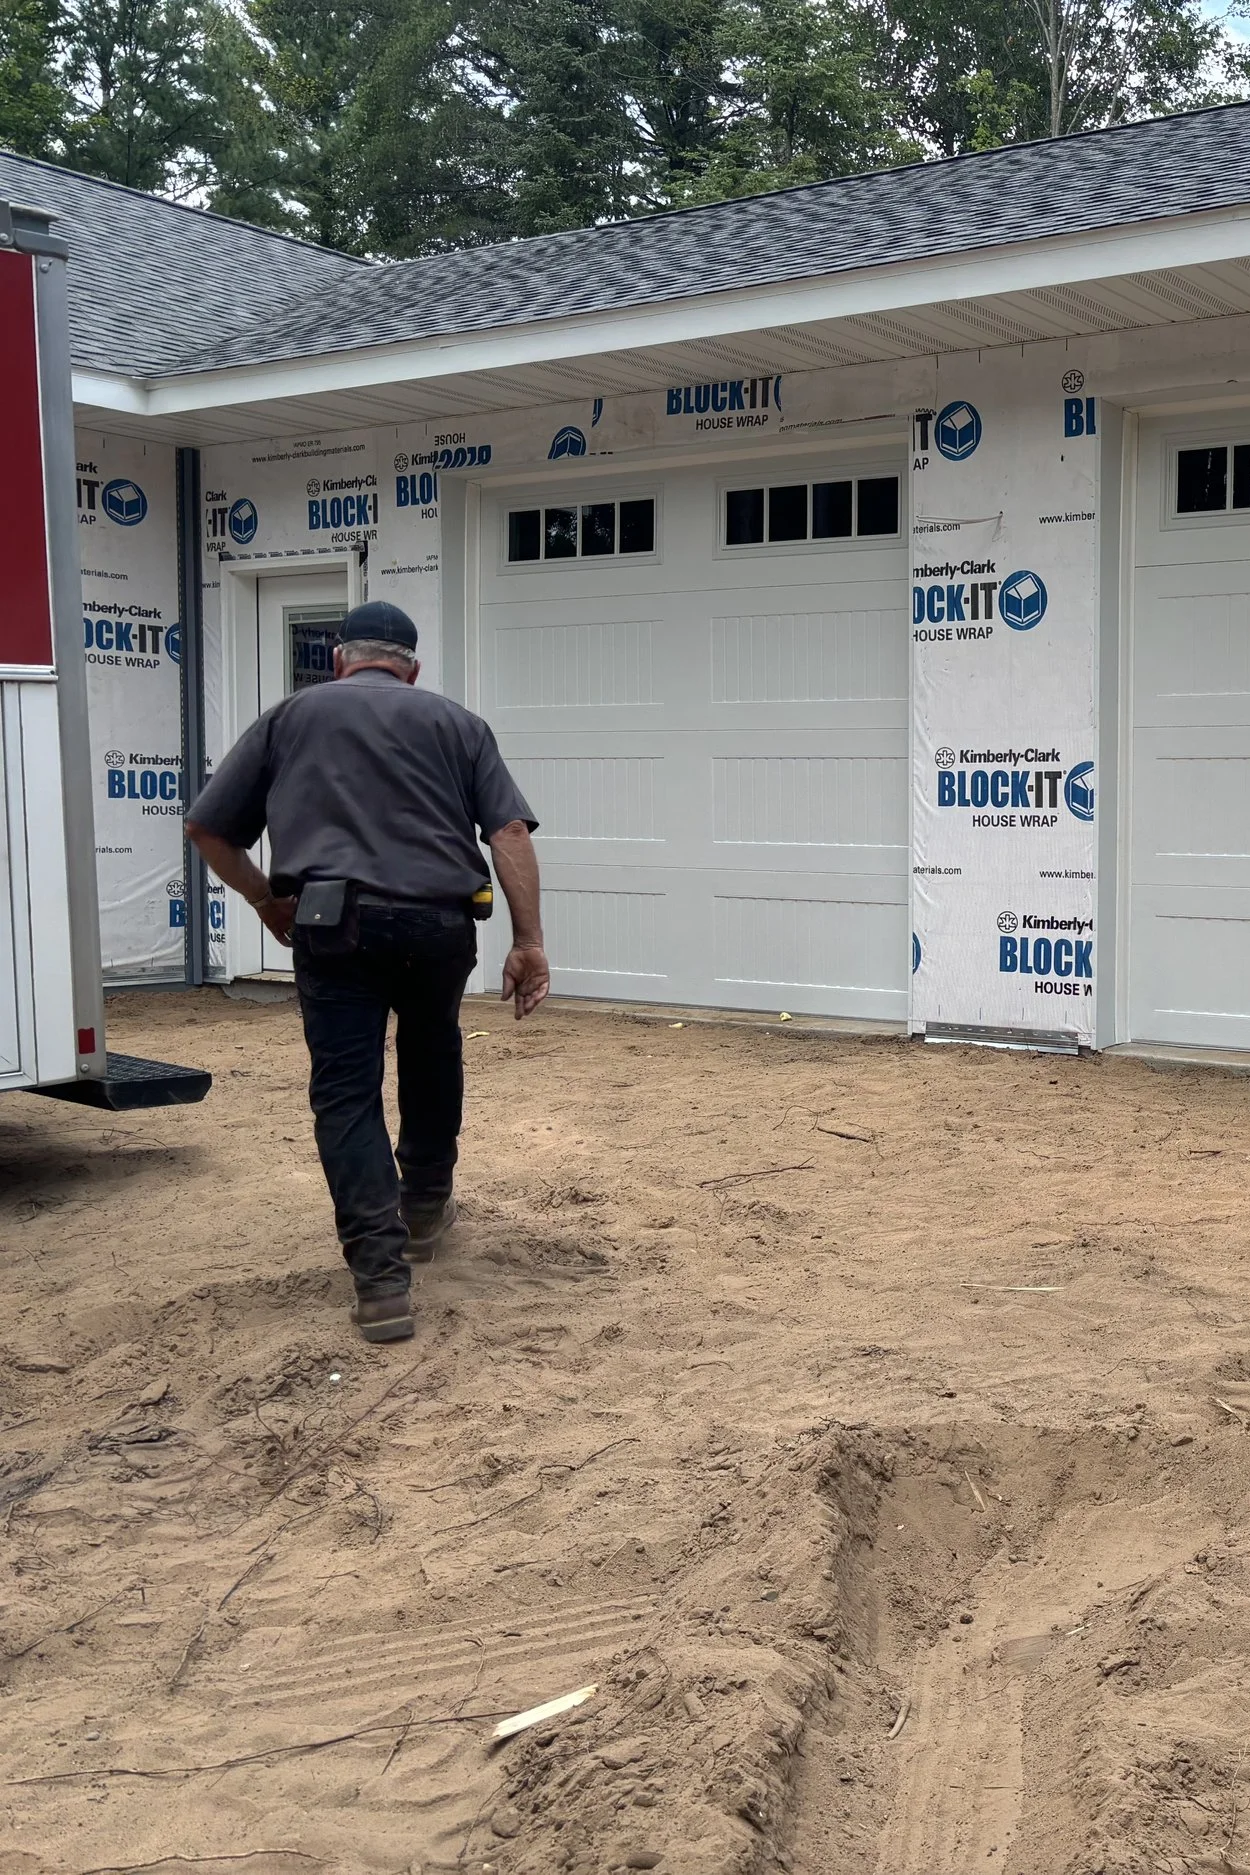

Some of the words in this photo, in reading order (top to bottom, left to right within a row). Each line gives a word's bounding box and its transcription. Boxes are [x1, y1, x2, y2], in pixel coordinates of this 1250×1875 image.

[696, 417, 733, 430] HOUSE
[736, 414, 768, 427] WRAP
[396, 472, 438, 508] BLO
[331, 531, 361, 543] HOUSE
[956, 627, 993, 640] WRAP
[85, 653, 121, 666] OUSE
[125, 656, 160, 669] WRAP
[959, 748, 1060, 766] Kimberly-Clark
[938, 770, 1062, 808] BLOCK-IT
[972, 815, 1016, 828] HOUSE
[1020, 815, 1058, 828] WRAP
[1000, 936, 1093, 978] BLOCK
[1035, 981, 1080, 996] HOUSE
